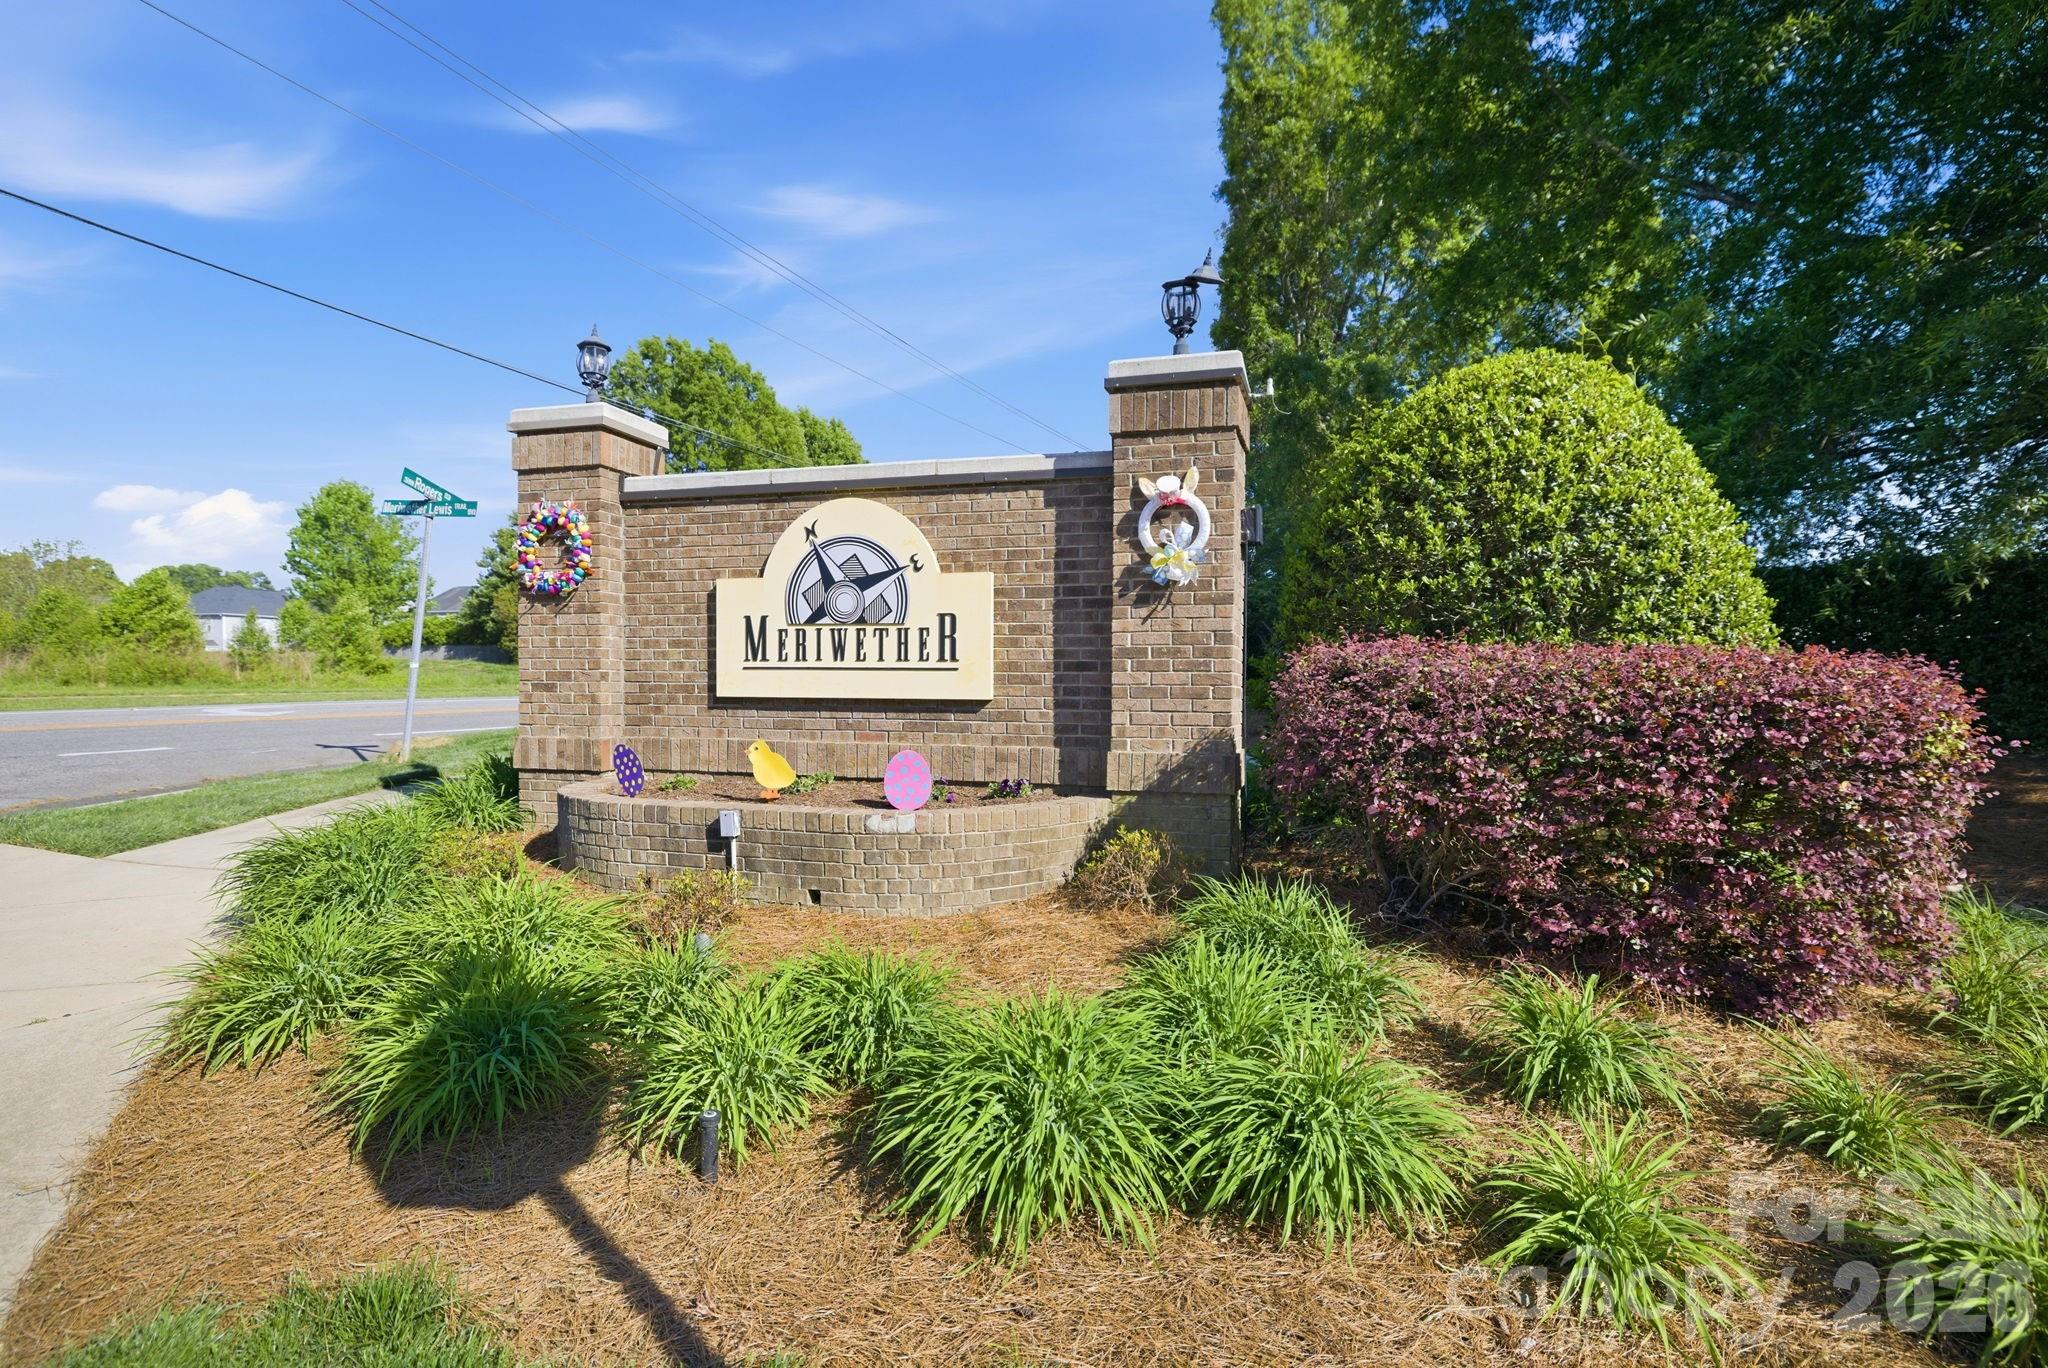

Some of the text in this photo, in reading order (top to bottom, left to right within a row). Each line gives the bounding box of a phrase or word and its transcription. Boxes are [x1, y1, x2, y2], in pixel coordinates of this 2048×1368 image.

[414, 476, 443, 502] Rogers
[382, 501, 428, 515] Meriwether
[429, 502, 453, 516] Lewis
